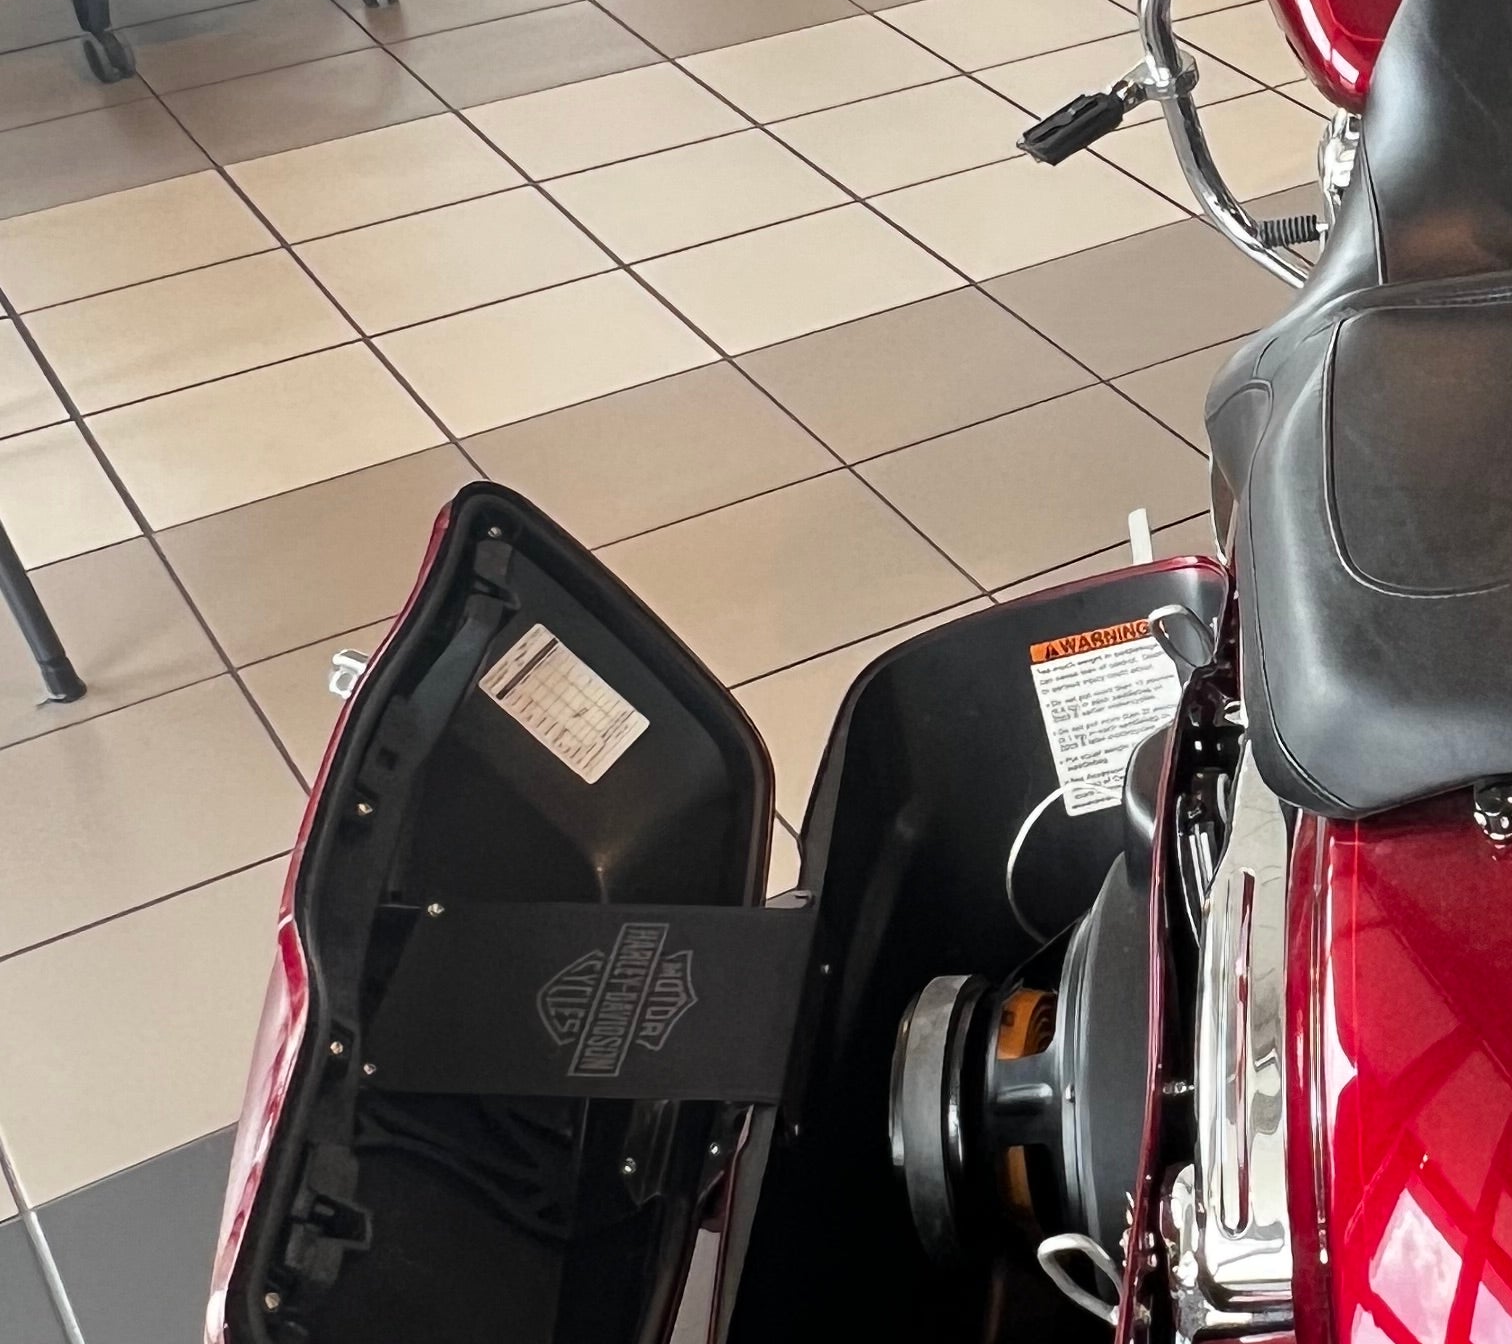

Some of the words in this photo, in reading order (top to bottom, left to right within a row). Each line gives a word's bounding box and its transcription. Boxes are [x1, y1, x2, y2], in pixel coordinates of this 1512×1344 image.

[1060, 621, 1149, 655] WARNING
[546, 960, 603, 1034] CYCLES
[579, 928, 659, 1070] HARLEY-DAVIDSON
[639, 961, 687, 1037] MOTOR
